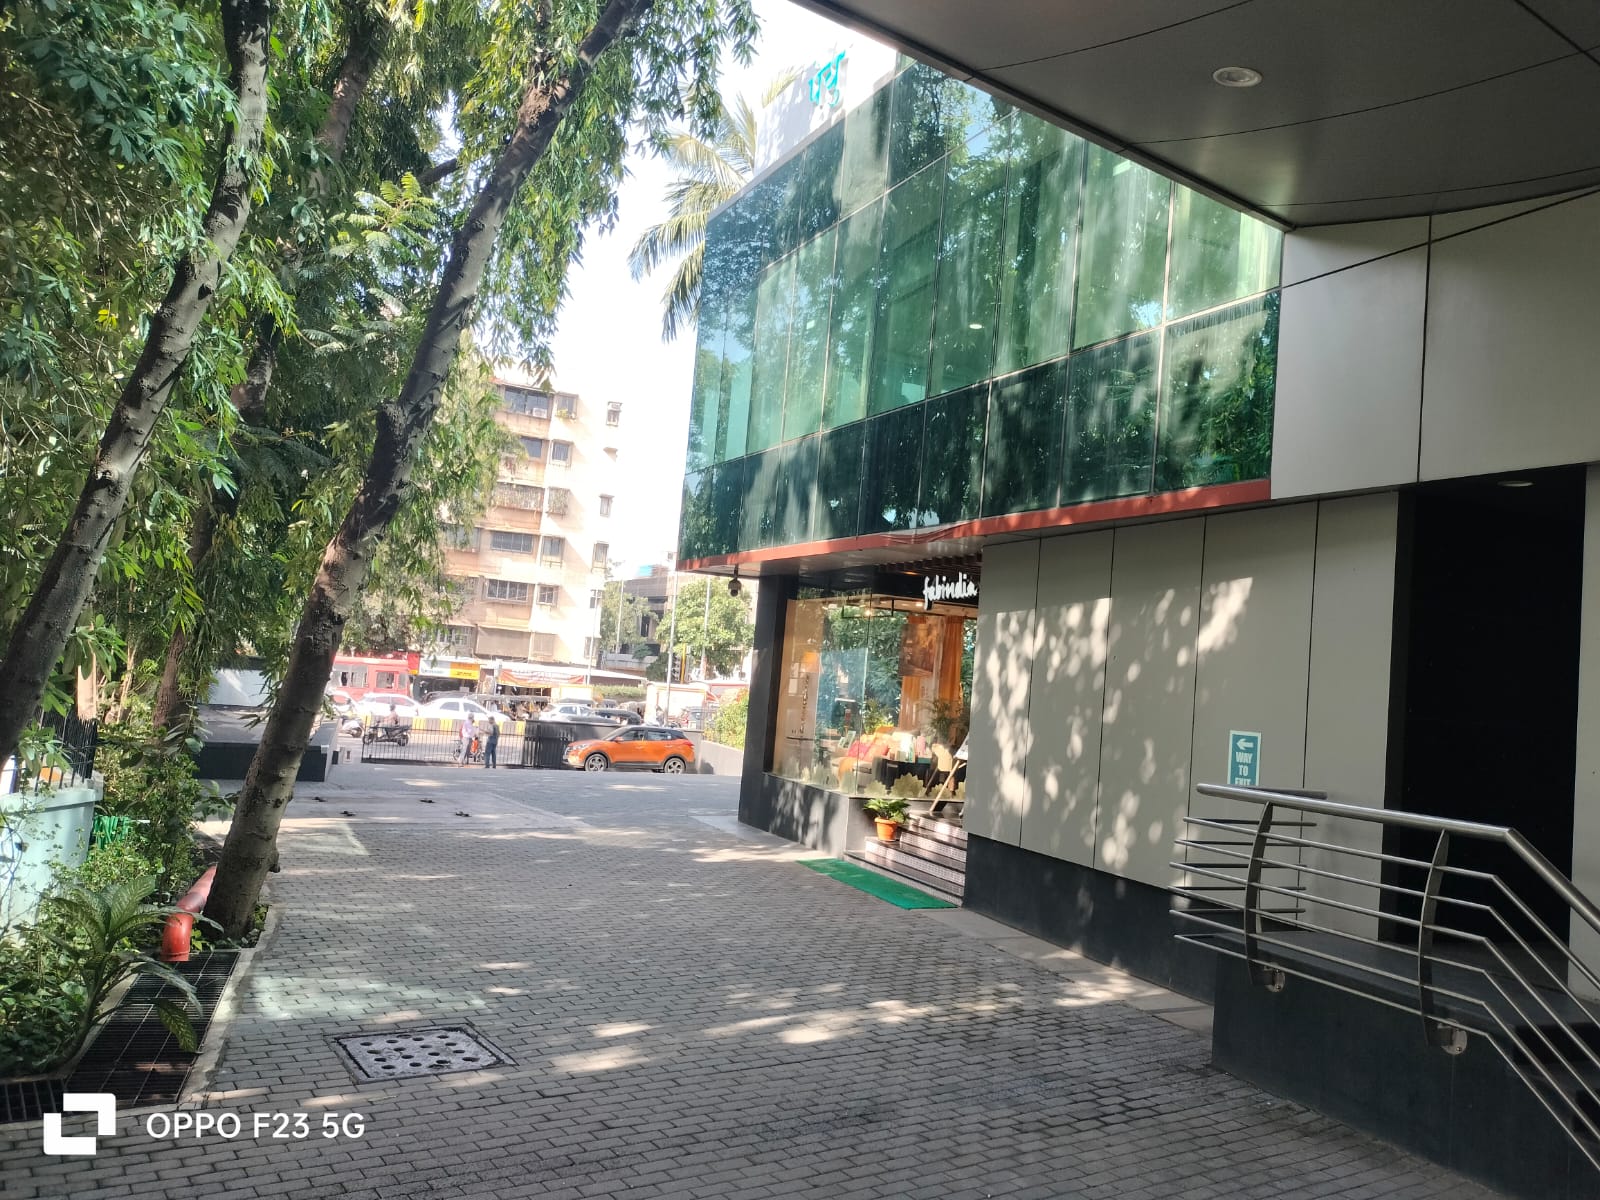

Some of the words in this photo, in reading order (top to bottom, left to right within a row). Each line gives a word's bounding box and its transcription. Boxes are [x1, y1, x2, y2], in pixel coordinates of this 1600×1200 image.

[923, 572, 978, 610] fabindia
[1235, 751, 1253, 764] WAY
[1238, 764, 1249, 777] TO
